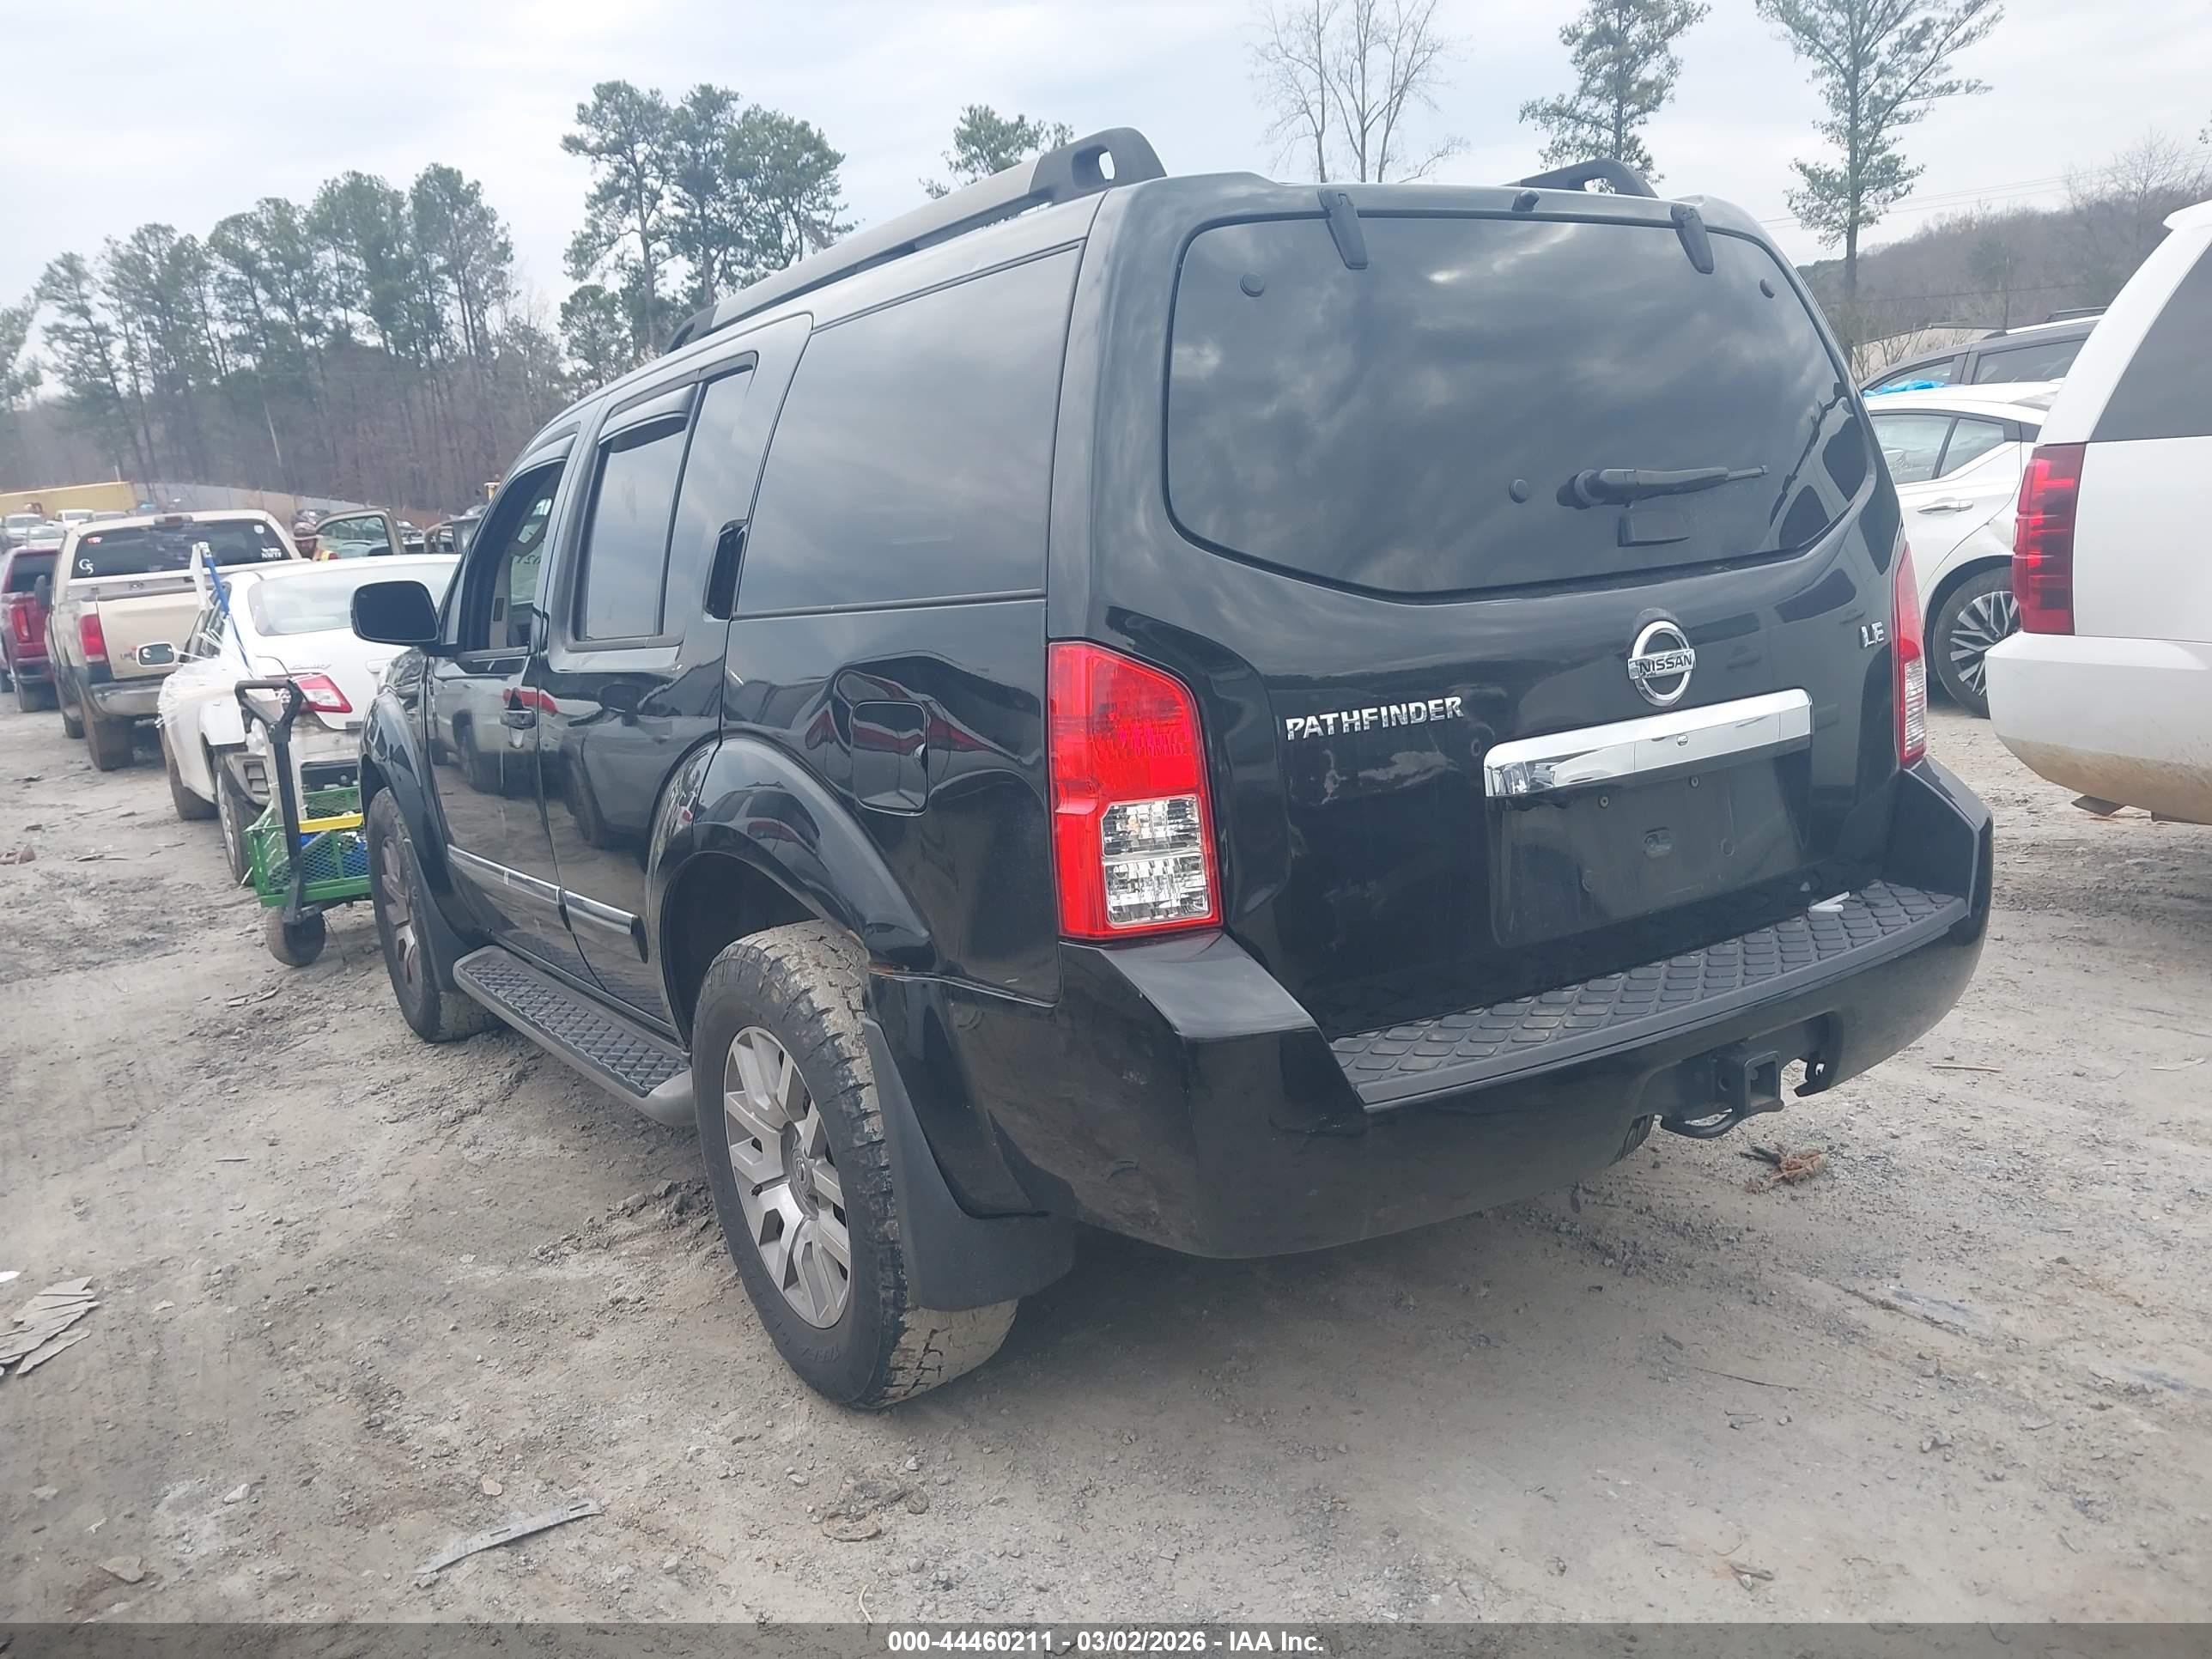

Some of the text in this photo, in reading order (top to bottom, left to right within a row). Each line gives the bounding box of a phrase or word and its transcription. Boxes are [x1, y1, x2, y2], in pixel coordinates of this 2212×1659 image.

[1861, 621, 1885, 647] LE
[1639, 653, 1692, 674] NISSAN
[1285, 696, 1464, 741] PATHFINDER
